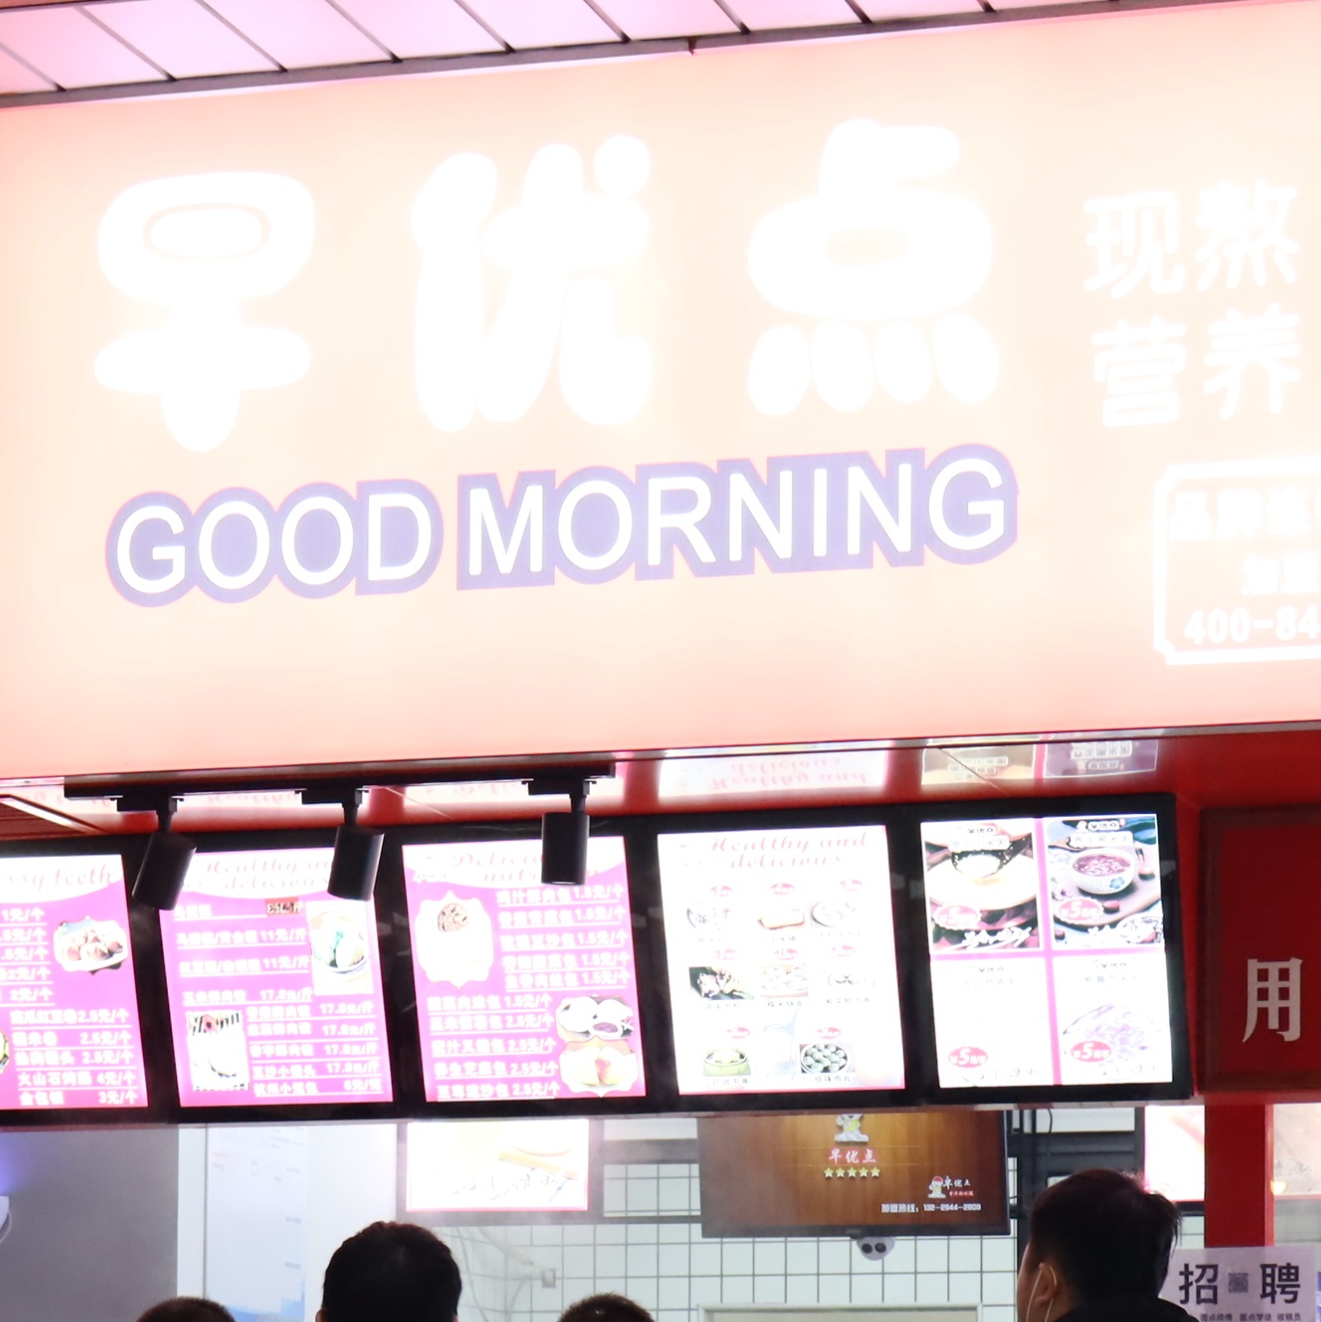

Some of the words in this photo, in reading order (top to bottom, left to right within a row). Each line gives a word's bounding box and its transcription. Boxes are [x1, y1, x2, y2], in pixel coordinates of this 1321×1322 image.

[1081, 177, 1299, 298] 现熬
[94, 118, 1000, 452] 早优点
[1089, 305, 1300, 429] 营养
[111, 485, 438, 602] GOOD
[464, 450, 1015, 584] MORNING
[54, 864, 112, 886] teeth
[711, 834, 809, 853] Healthy
[820, 832, 867, 848] and
[730, 854, 840, 868] delicious
[1179, 1263, 1219, 1305] 招
[1260, 1262, 1301, 1307] 聘
